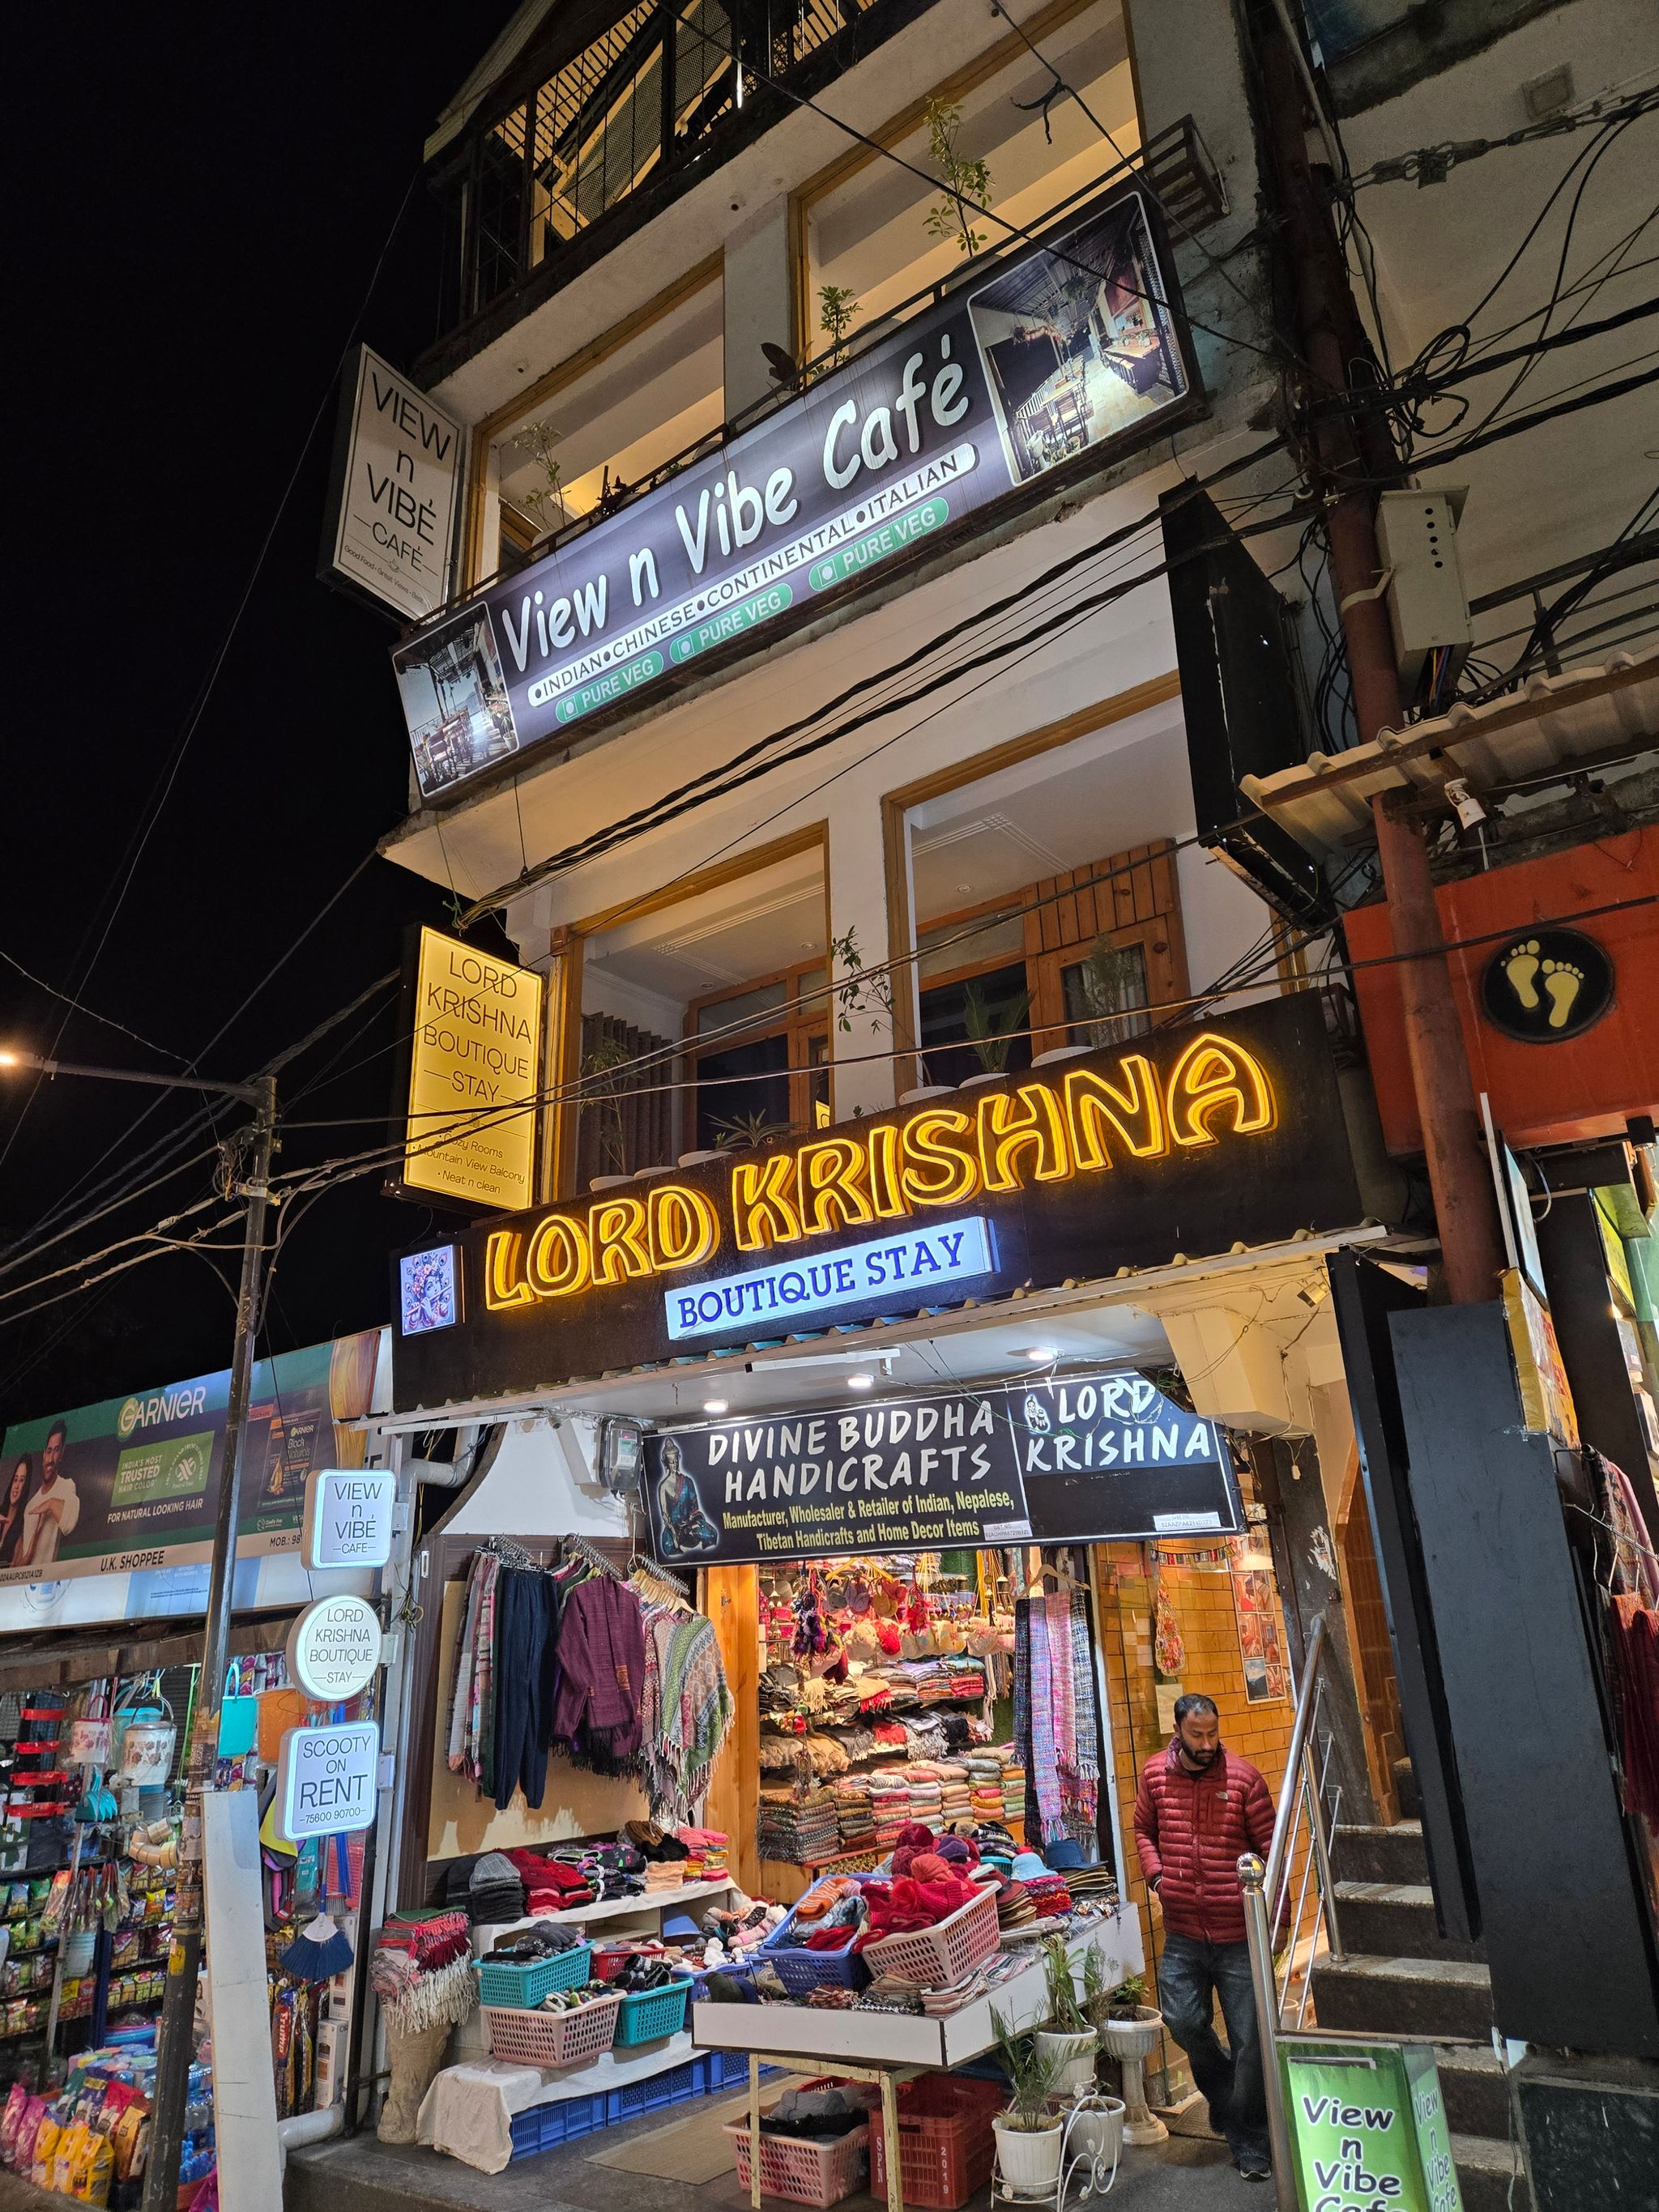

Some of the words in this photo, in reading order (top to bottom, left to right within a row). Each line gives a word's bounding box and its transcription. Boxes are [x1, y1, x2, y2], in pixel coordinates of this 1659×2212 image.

[372, 371, 451, 461] VIEW
[396, 450, 415, 484] n
[501, 574, 607, 672] View
[629, 548, 659, 607] n
[675, 467, 798, 574] Vibe
[823, 334, 969, 490] Café
[842, 531, 893, 573] PURE
[893, 505, 936, 539] VEG
[344, 545, 360, 560] Good
[360, 555, 375, 569] Food
[377, 567, 394, 583] Great
[543, 653, 603, 697] INDIAN
[612, 602, 697, 658] CHINESE
[706, 517, 855, 608] CONTINENTAL
[868, 454, 959, 520] ITALIAN
[699, 612, 744, 647] PURE
[745, 591, 782, 620] VEG
[582, 679, 620, 710] PURE
[622, 659, 655, 685] VEG
[449, 951, 518, 999] LORD
[427, 982, 532, 1045] KRISHNA
[423, 1024, 529, 1080] BOUTIQUE
[451, 1070, 500, 1103] STAY
[471, 1140, 503, 1159] Rooms
[442, 1170, 467, 1185] Neat
[467, 1178, 475, 1187] n
[476, 1180, 501, 1194] clean
[466, 1157, 488, 1172] View
[489, 1164, 526, 1185] Balcony
[485, 1186, 718, 1311] LORD
[732, 1033, 1276, 1251] KRISHNA
[677, 1258, 856, 1329] BOUTIQUE
[865, 1231, 966, 1287] STAY
[120, 1386, 207, 1433] GARNIER
[1059, 1379, 1156, 1424] LORD
[708, 1419, 826, 1466] DIVINE
[838, 1400, 994, 1452] BUDDHA
[1026, 1423, 1210, 1472] KRISHNA
[121, 1464, 160, 1484] TRUSTED
[144, 1455, 163, 1466] MOST
[725, 1443, 992, 1503] HANDICRAFTS
[118, 1483, 133, 1494] HAIR
[335, 1482, 382, 1500] VIEW
[107, 1512, 121, 1524] FOR
[121, 1507, 151, 1521] NATURAL
[152, 1502, 184, 1516] LOOKING
[186, 1498, 203, 1511] HAIR
[352, 1504, 362, 1518] n
[723, 1507, 789, 1530] Manufacturer,
[789, 1502, 845, 1524] Wholesaler
[847, 1502, 856, 1519] &
[859, 1498, 900, 1518] Retailer
[902, 1496, 914, 1514] of
[915, 1492, 955, 1515] Indian,
[956, 1489, 1015, 1512] Nepalese,
[341, 1542, 369, 1554] CAFE
[756, 1530, 794, 1551] Tibetan
[796, 1526, 855, 1547] Handicrafts
[856, 1524, 876, 1543] and
[878, 1522, 910, 1541] Home
[911, 1519, 945, 1539] Decor
[946, 1518, 979, 1537] Items
[100, 1557, 117, 1572] U.K.
[120, 1550, 165, 1570] SHOPPEE
[327, 1609, 364, 1622] LORD
[315, 1628, 370, 1643] KRISHNA
[309, 1649, 373, 1665] BOUTIQUE
[326, 1671, 352, 1683] STAY
[303, 1735, 371, 1758] SCOOTY
[326, 1758, 347, 1774] ON
[300, 1774, 368, 1809] RENT
[334, 1806, 360, 1820] 90700
[1303, 2096, 1394, 2130] View
[1415, 2088, 1439, 2126] View
[1341, 2138, 1363, 2160] n
[1430, 2129, 1437, 2152] n
[1315, 2161, 1401, 2196] Vibe
[1427, 2154, 1450, 2192] Vibe
